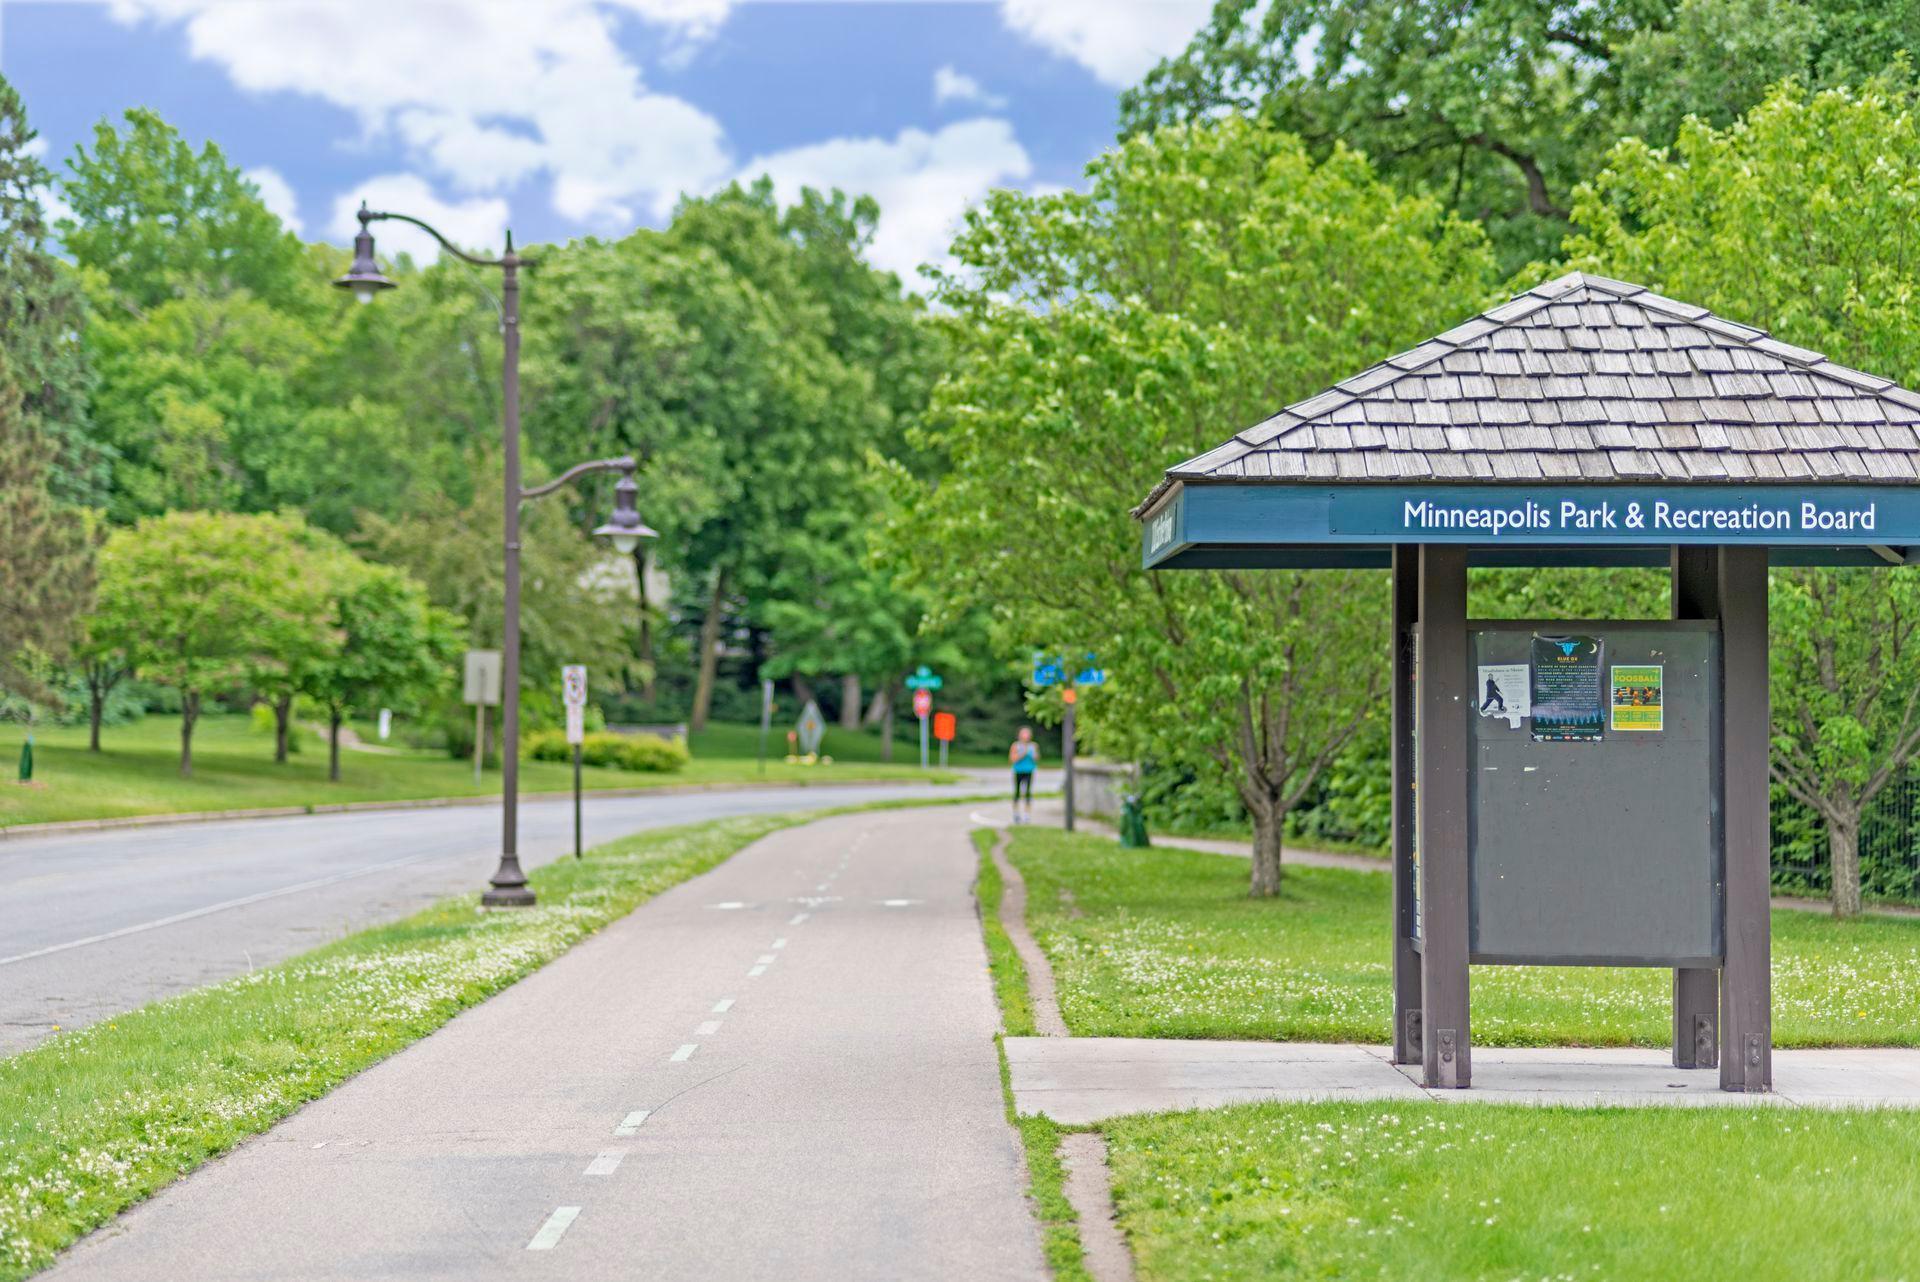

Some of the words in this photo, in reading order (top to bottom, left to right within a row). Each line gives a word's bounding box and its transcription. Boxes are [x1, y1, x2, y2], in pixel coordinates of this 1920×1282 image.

[1404, 501, 1551, 536] Minneapolis
[1560, 501, 1617, 528] Park
[1624, 502, 1645, 529] &
[1654, 501, 1791, 529] Recreation
[1801, 502, 1875, 530] Board
